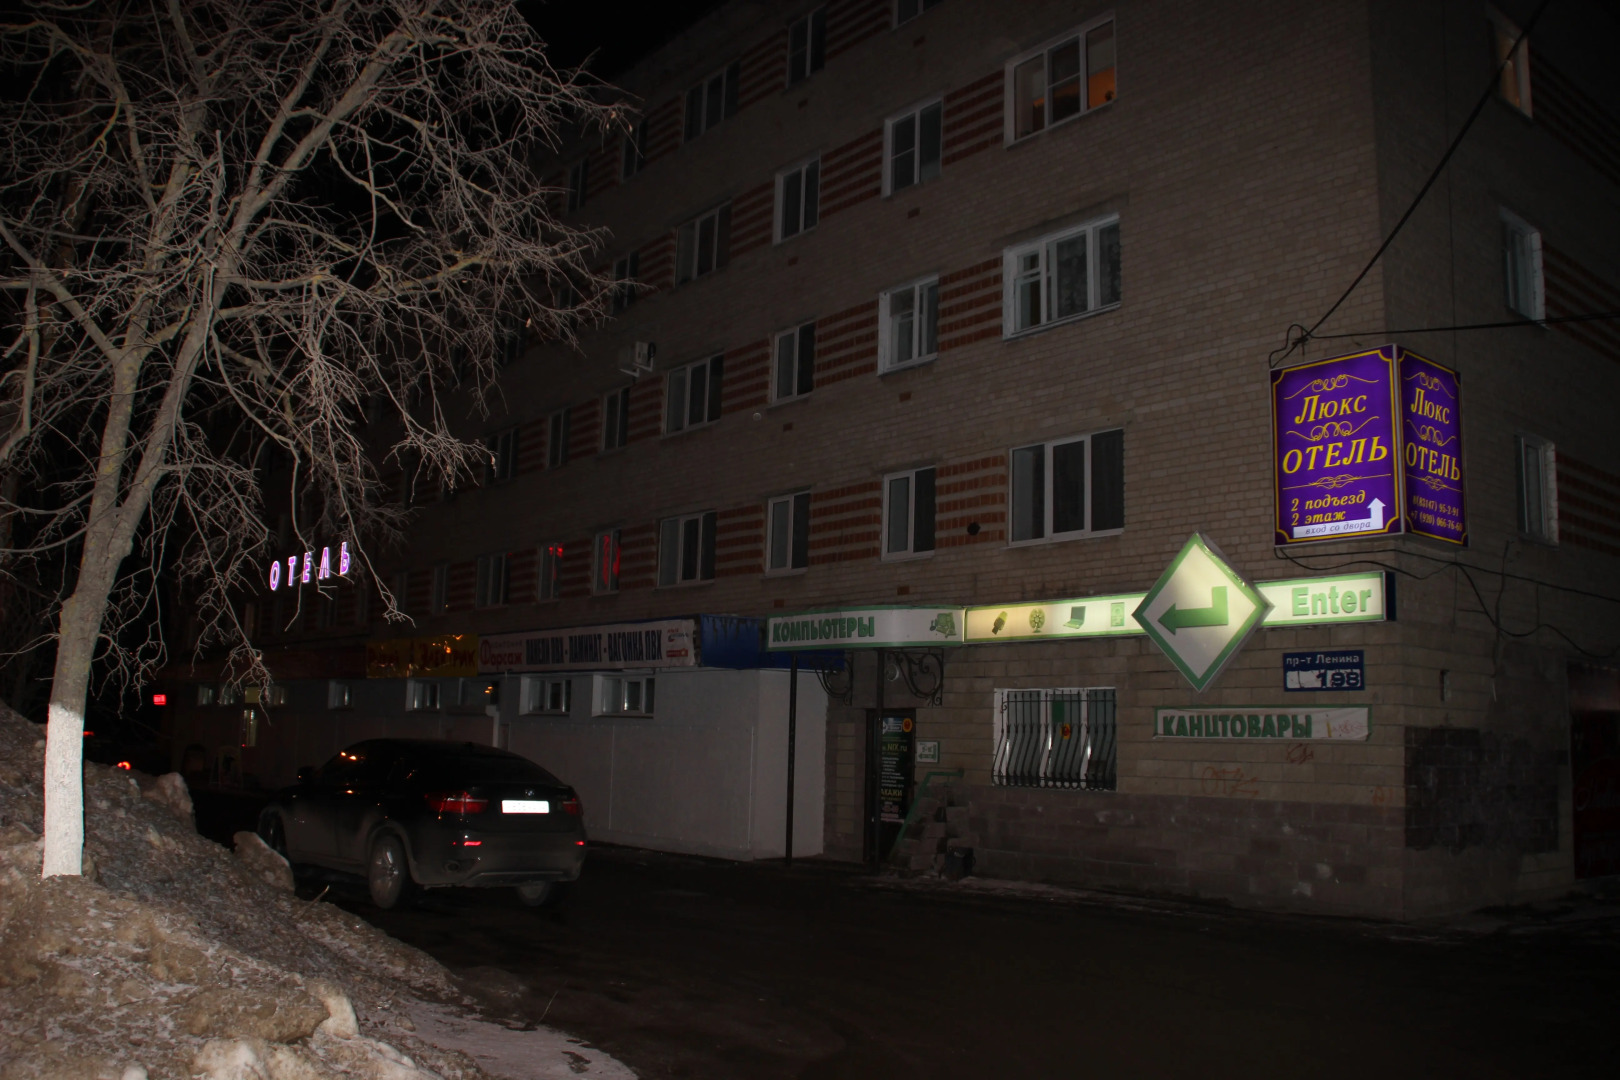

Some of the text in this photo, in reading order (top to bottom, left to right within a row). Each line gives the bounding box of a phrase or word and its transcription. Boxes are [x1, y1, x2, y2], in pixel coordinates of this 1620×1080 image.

[1294, 394, 1368, 425] Люкс
[1410, 387, 1451, 425] Люкс
[1282, 436, 1389, 475] ОТЕЛЬ
[1405, 441, 1462, 481] ОТЕЛЬ
[1290, 490, 1366, 513] 2 подъезд
[1290, 509, 1346, 526] 2 этаж
[1305, 520, 1372, 536] вход со двора
[269, 540, 351, 592] ОТЕЛЬ
[1291, 584, 1373, 617] Enter
[772, 615, 876, 642] КОМПЬЮТЕРЫ
[568, 632, 602, 664] ЛАМИНАТ
[608, 630, 644, 663] ВАГОНКА
[645, 628, 663, 661] ПВХ
[1285, 653, 1360, 667] пр-т Ленина
[1316, 671, 1360, 689] 198
[1162, 713, 1313, 739] КАНЦТОВАРЫ
